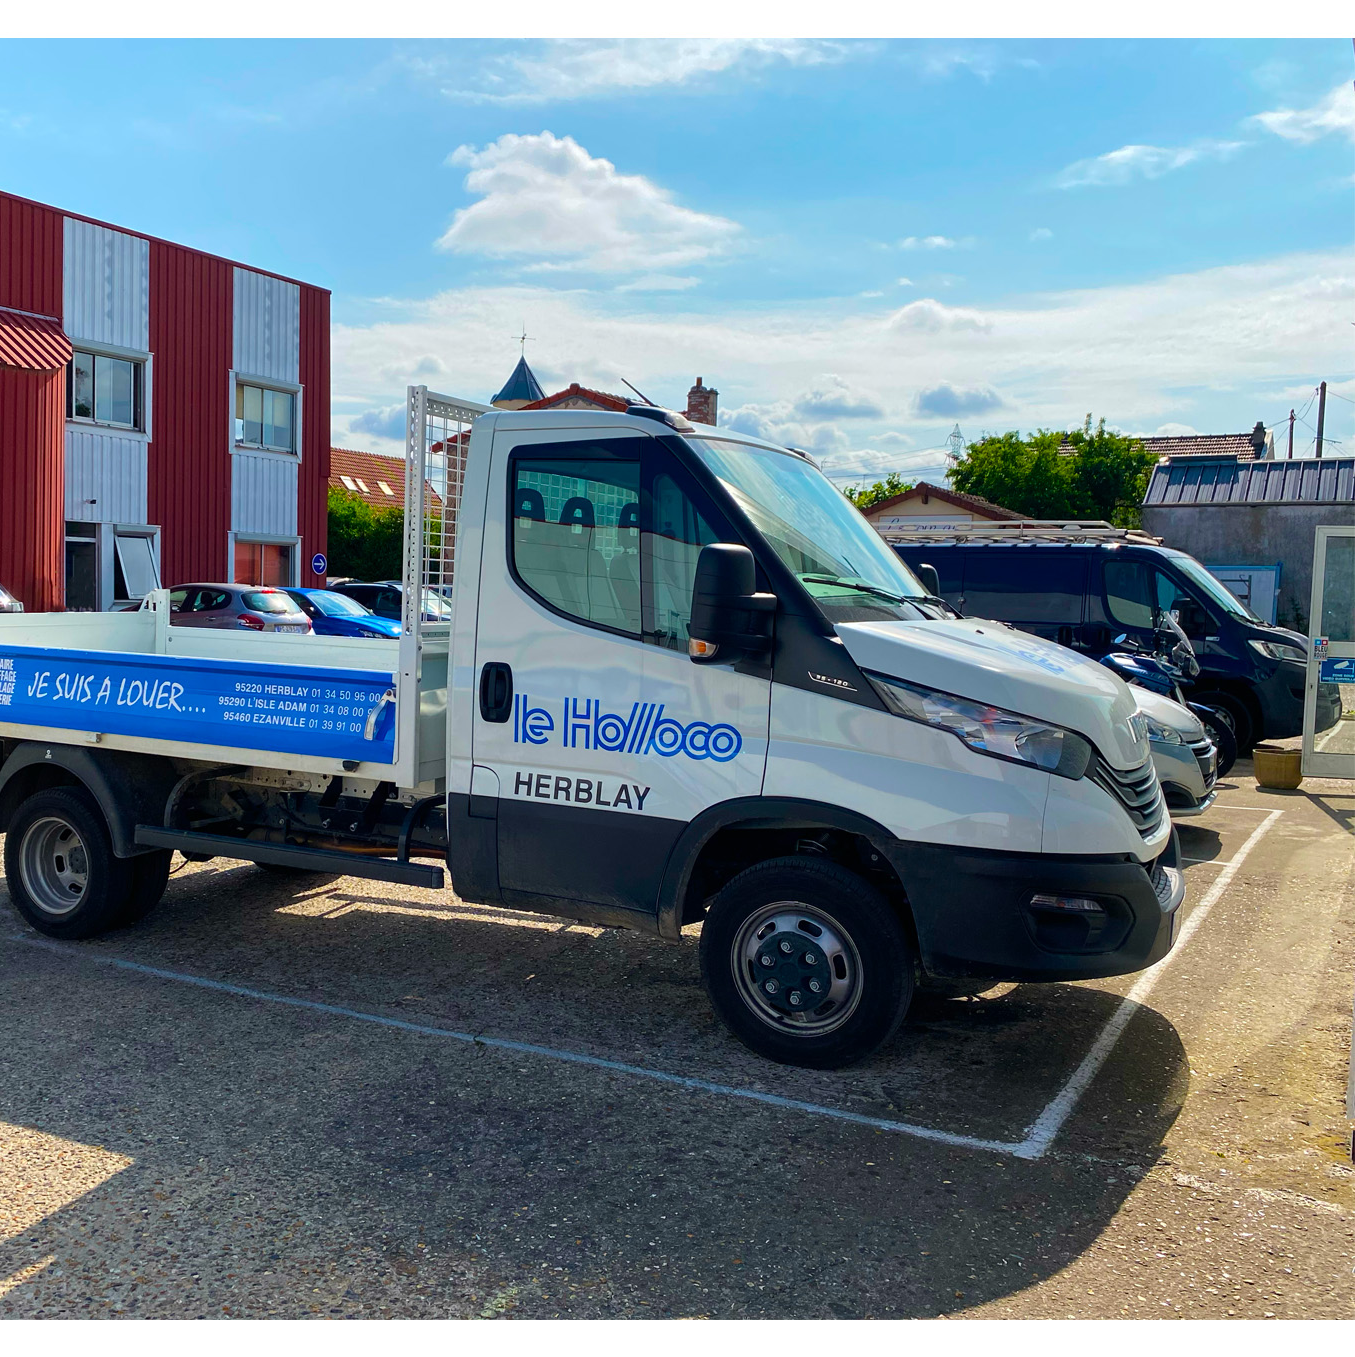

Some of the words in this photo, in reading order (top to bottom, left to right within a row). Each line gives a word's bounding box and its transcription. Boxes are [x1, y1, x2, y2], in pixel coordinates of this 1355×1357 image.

[28, 671, 50, 698] JE
[52, 672, 94, 703] SUIS
[95, 676, 111, 705] A
[235, 682, 262, 693] 95220
[264, 684, 309, 698] HERBLAY
[311, 688, 321, 698] 01
[324, 690, 336, 700] 34
[340, 690, 351, 700] 50
[354, 692, 366, 702] 95
[368, 692, 381, 703] 00
[218, 696, 246, 707] 95290
[247, 697, 276, 710] L'ISLE
[278, 702, 307, 712] ADAM
[310, 704, 320, 713] 01
[323, 704, 334, 714] 34
[338, 705, 349, 716] 08
[352, 706, 364, 717] 00
[514, 694, 555, 744] le
[223, 712, 251, 722] 95460
[252, 714, 306, 728] EZANVILLE
[308, 719, 318, 728] 01
[322, 720, 333, 730] 39
[336, 721, 346, 731] 91
[350, 722, 362, 733] 00
[514, 771, 651, 811] HERBLAY
